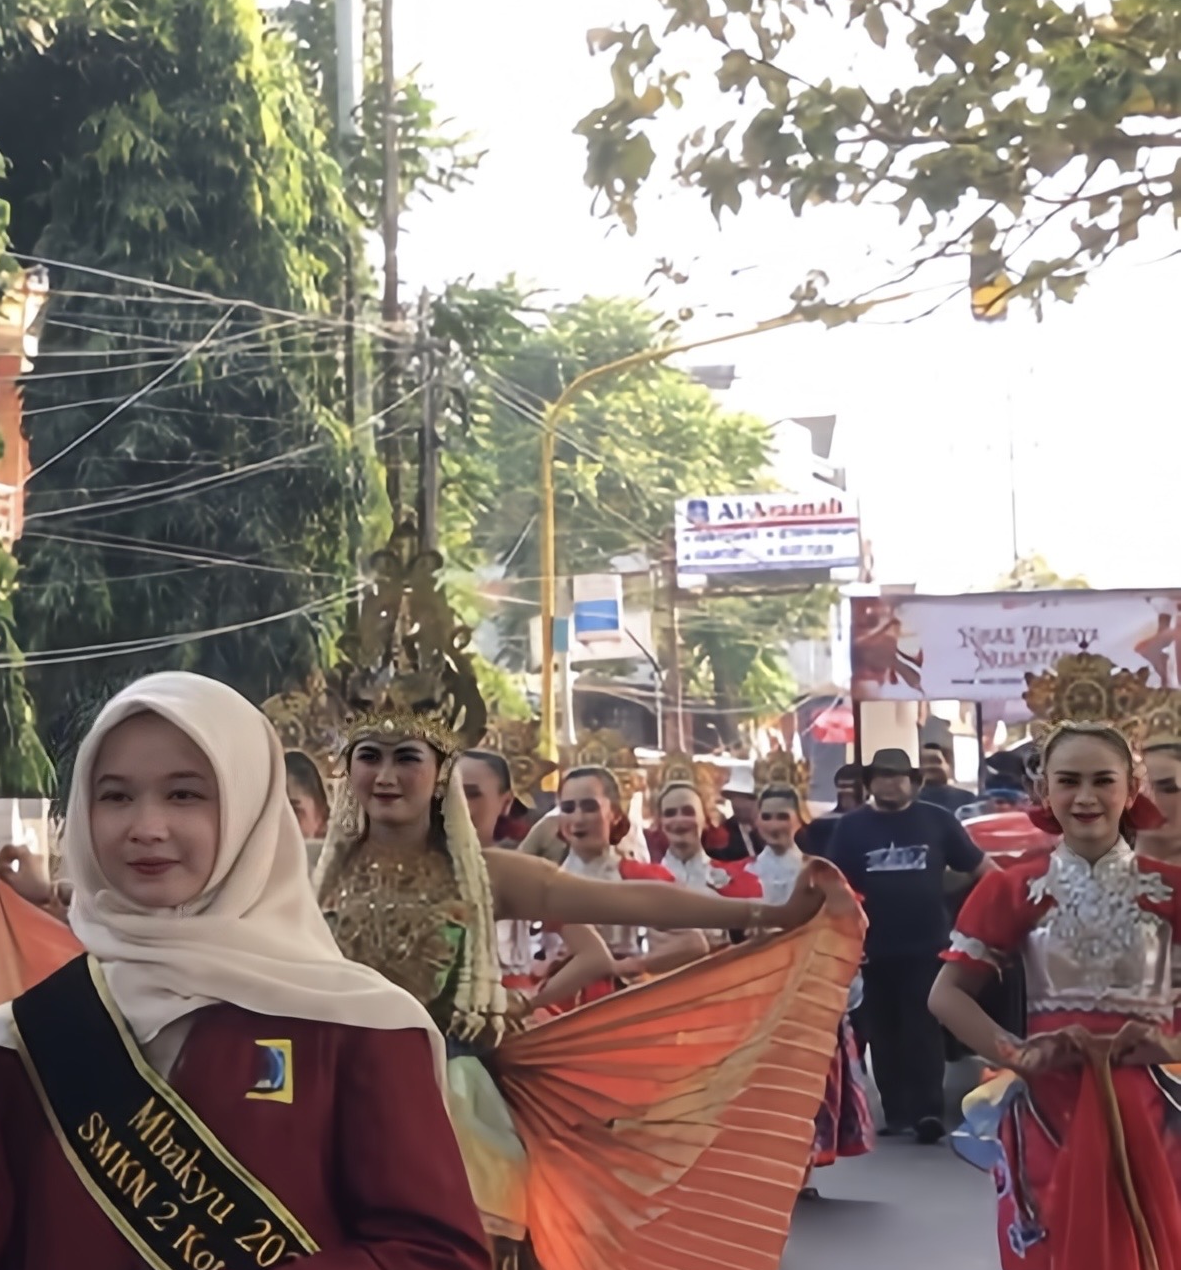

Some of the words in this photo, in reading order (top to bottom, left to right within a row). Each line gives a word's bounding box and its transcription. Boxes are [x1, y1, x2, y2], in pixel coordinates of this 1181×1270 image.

[78, 1112, 158, 1209] SMKN
[146, 1201, 179, 1231] 2
[127, 1096, 235, 1225] Mbakyu
